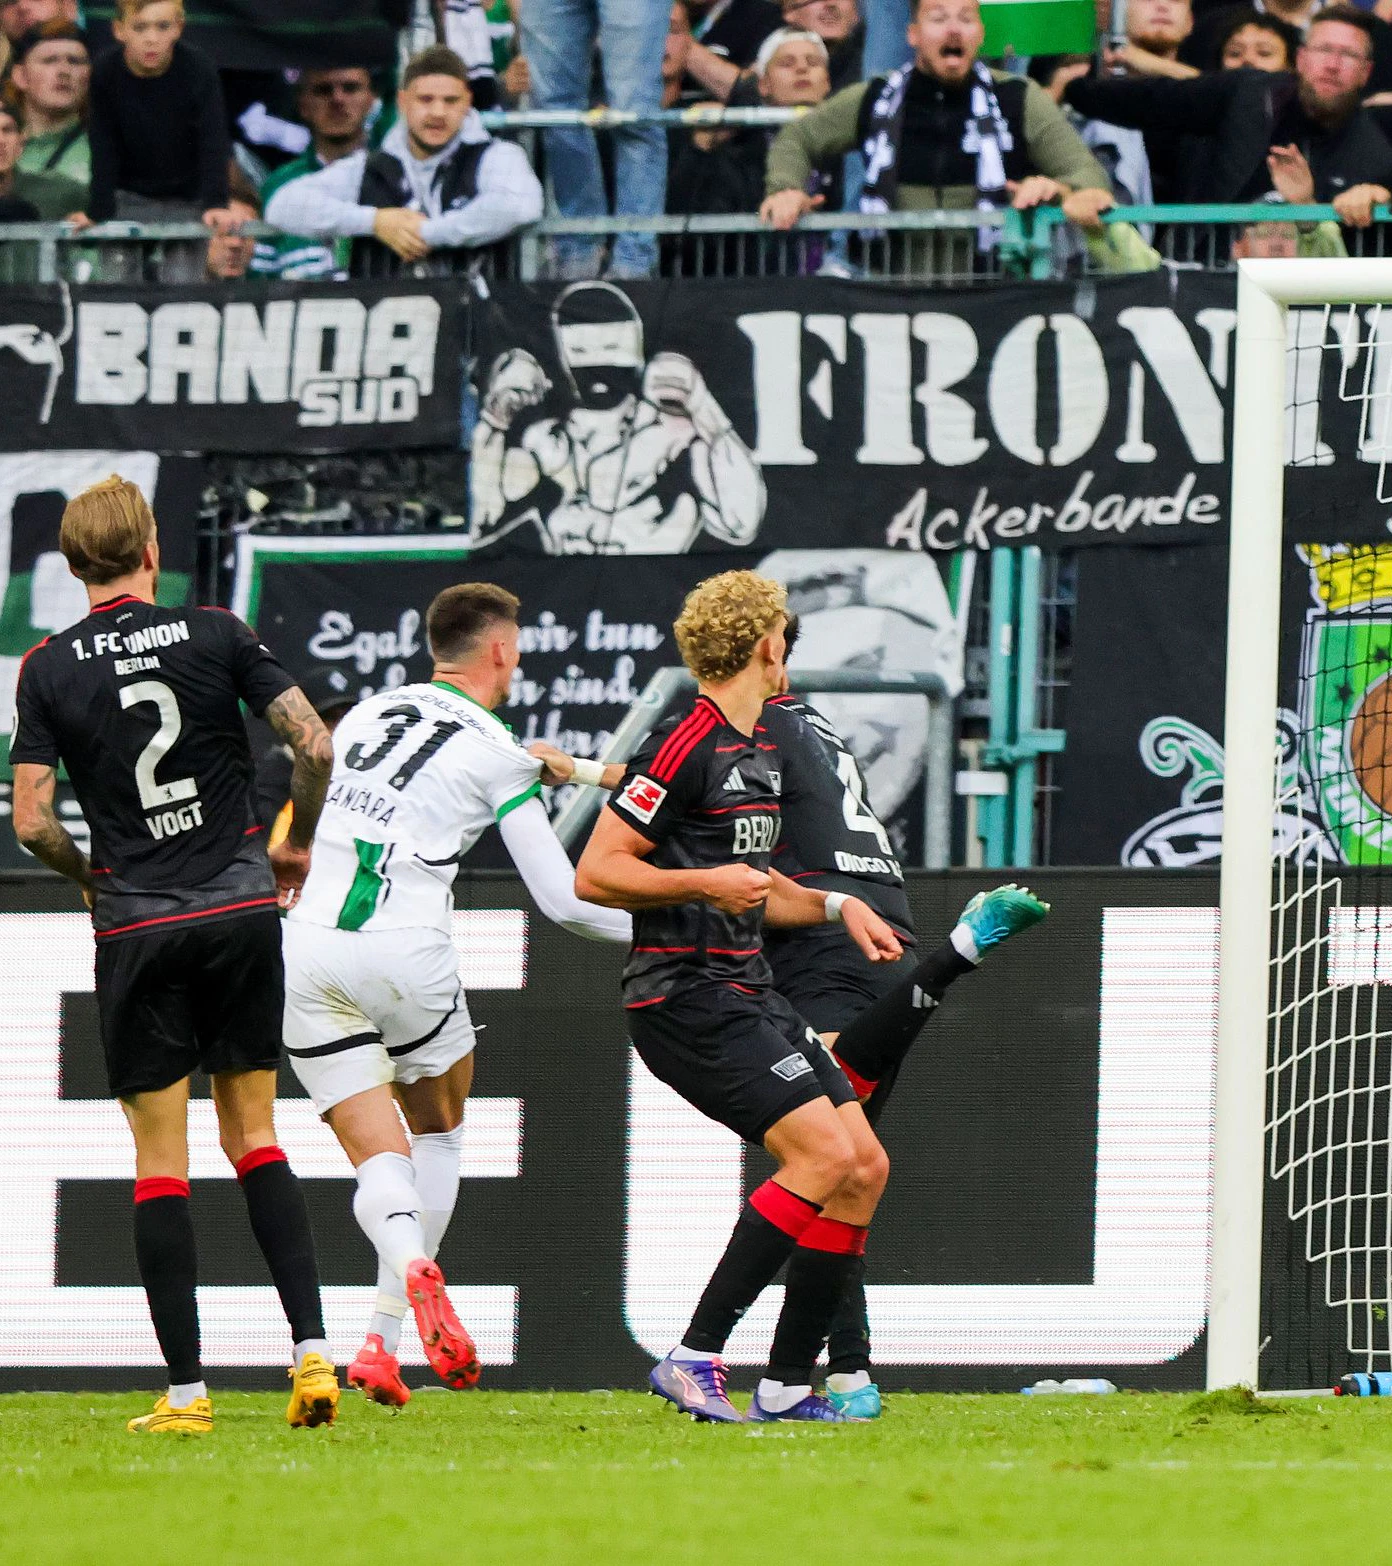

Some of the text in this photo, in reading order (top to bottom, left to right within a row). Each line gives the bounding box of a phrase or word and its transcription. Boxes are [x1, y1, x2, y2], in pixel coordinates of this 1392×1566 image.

[76, 296, 441, 404] BANDA
[298, 376, 419, 427] SUD
[886, 471, 1220, 551] Ackerbande
[71, 620, 191, 661] 1. FC UNION
[113, 655, 162, 676] BERLIN
[118, 680, 199, 811] 2
[344, 703, 465, 792] 31
[145, 800, 204, 841] VOGT
[836, 750, 894, 856] 4
